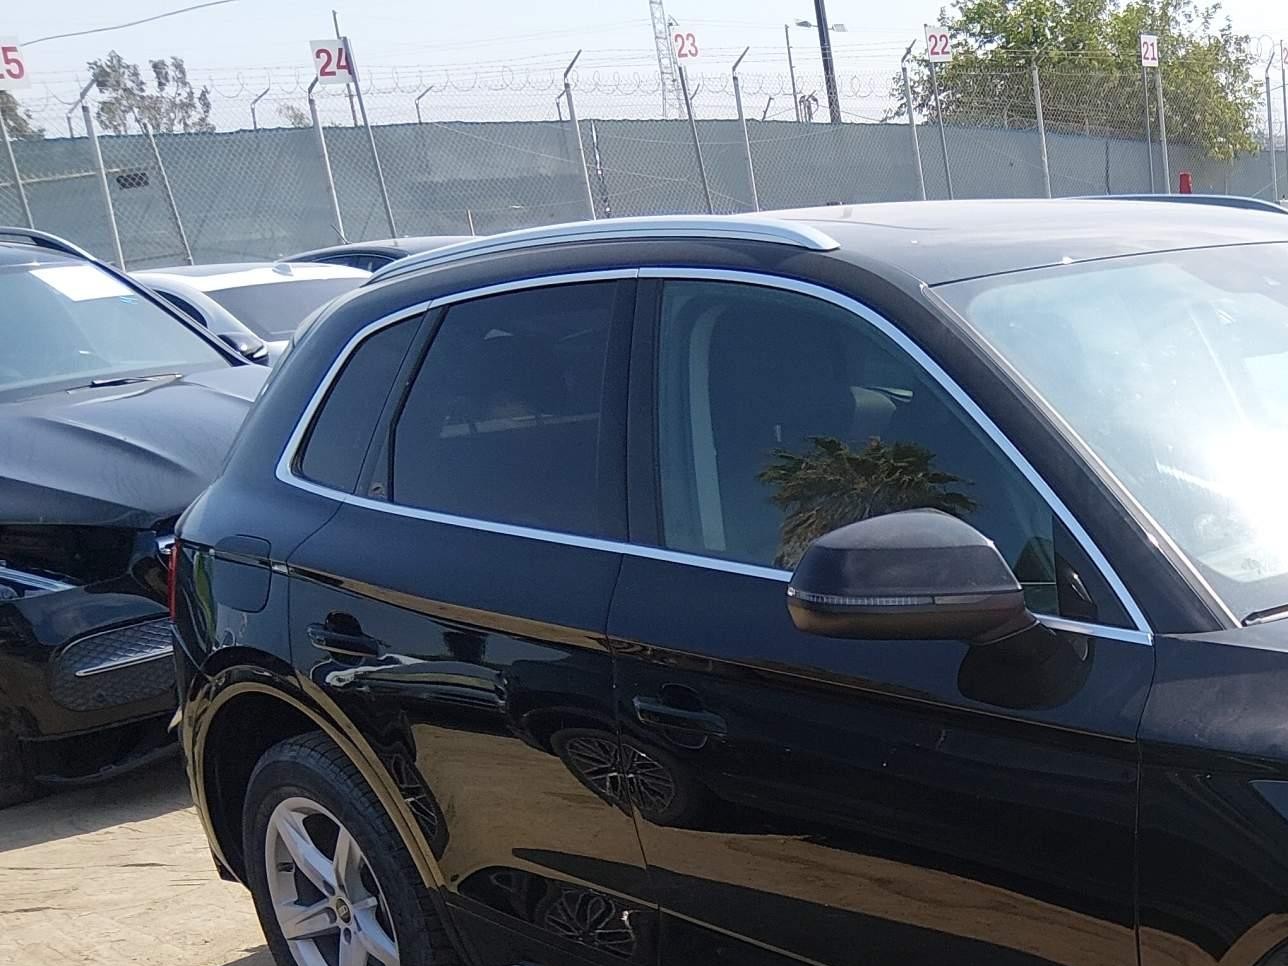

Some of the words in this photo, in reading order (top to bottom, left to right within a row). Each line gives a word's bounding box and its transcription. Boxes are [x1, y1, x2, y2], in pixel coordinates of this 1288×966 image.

[674, 32, 699, 58] 23
[928, 33, 950, 56] 22
[1142, 41, 1157, 61] 21
[0, 45, 25, 80] 5
[315, 47, 353, 77] 24
